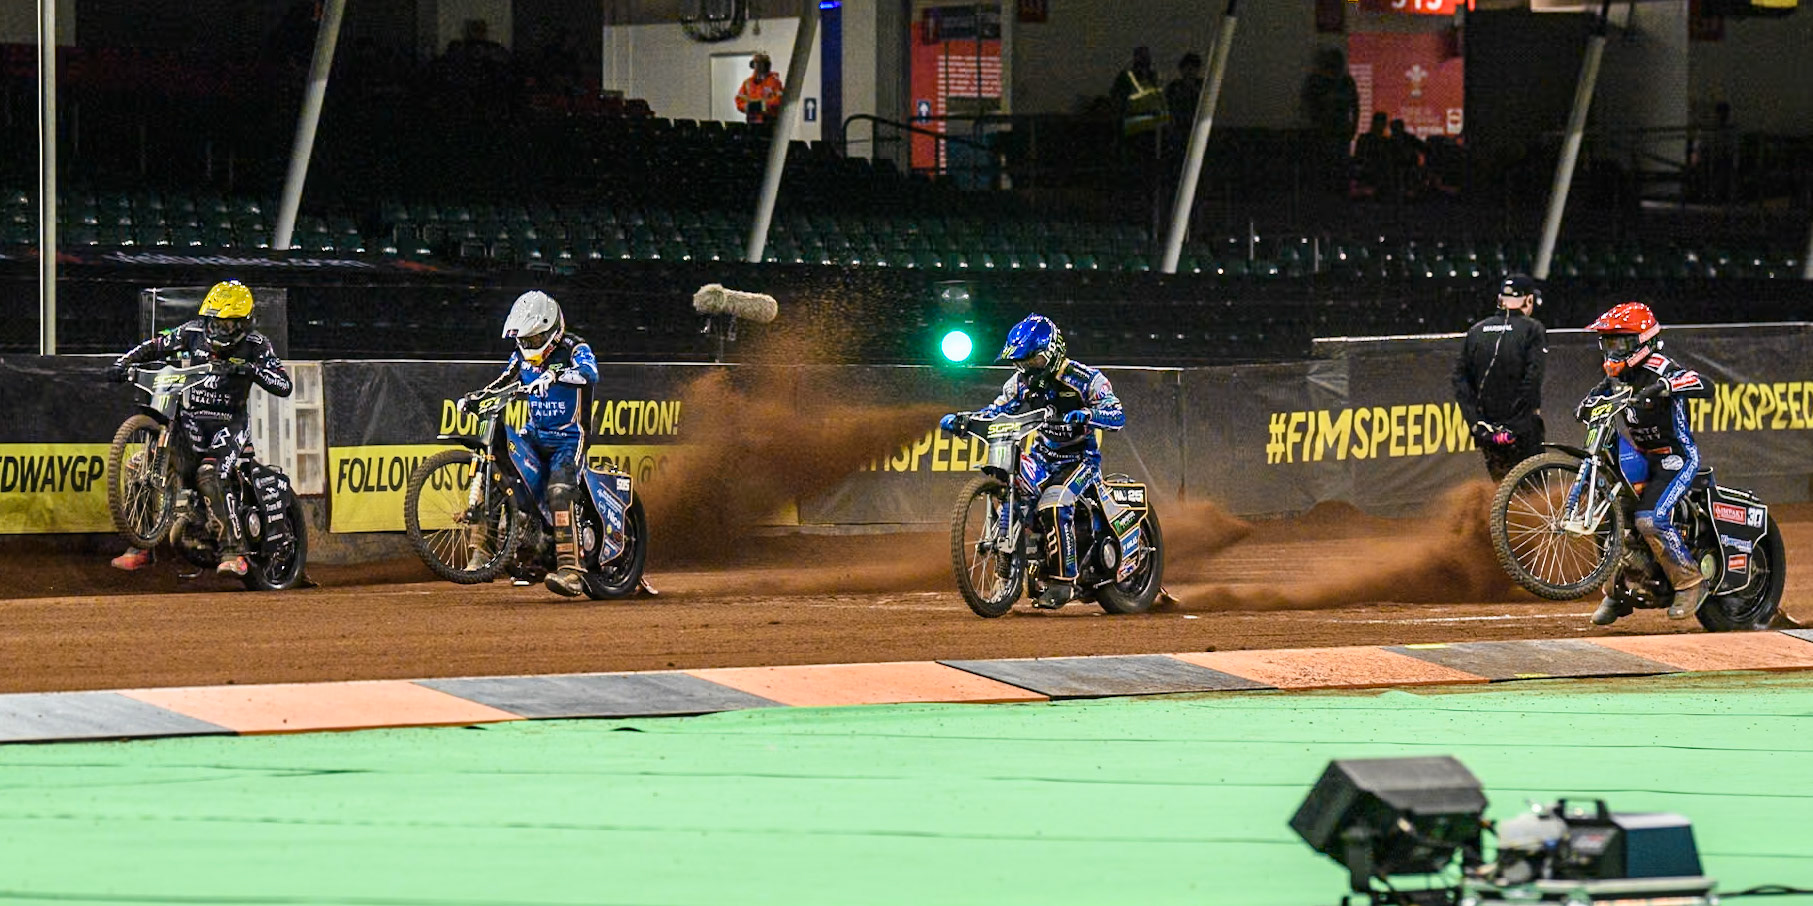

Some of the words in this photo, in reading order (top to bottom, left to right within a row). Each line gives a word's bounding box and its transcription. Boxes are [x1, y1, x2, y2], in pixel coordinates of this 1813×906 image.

[600, 400, 681, 436] ACTION!
[1266, 402, 1476, 464] #FIMSPEEDW
[0, 455, 105, 493] DWAYGP
[1127, 489, 1144, 503] 25
[1747, 507, 1764, 528] 30
